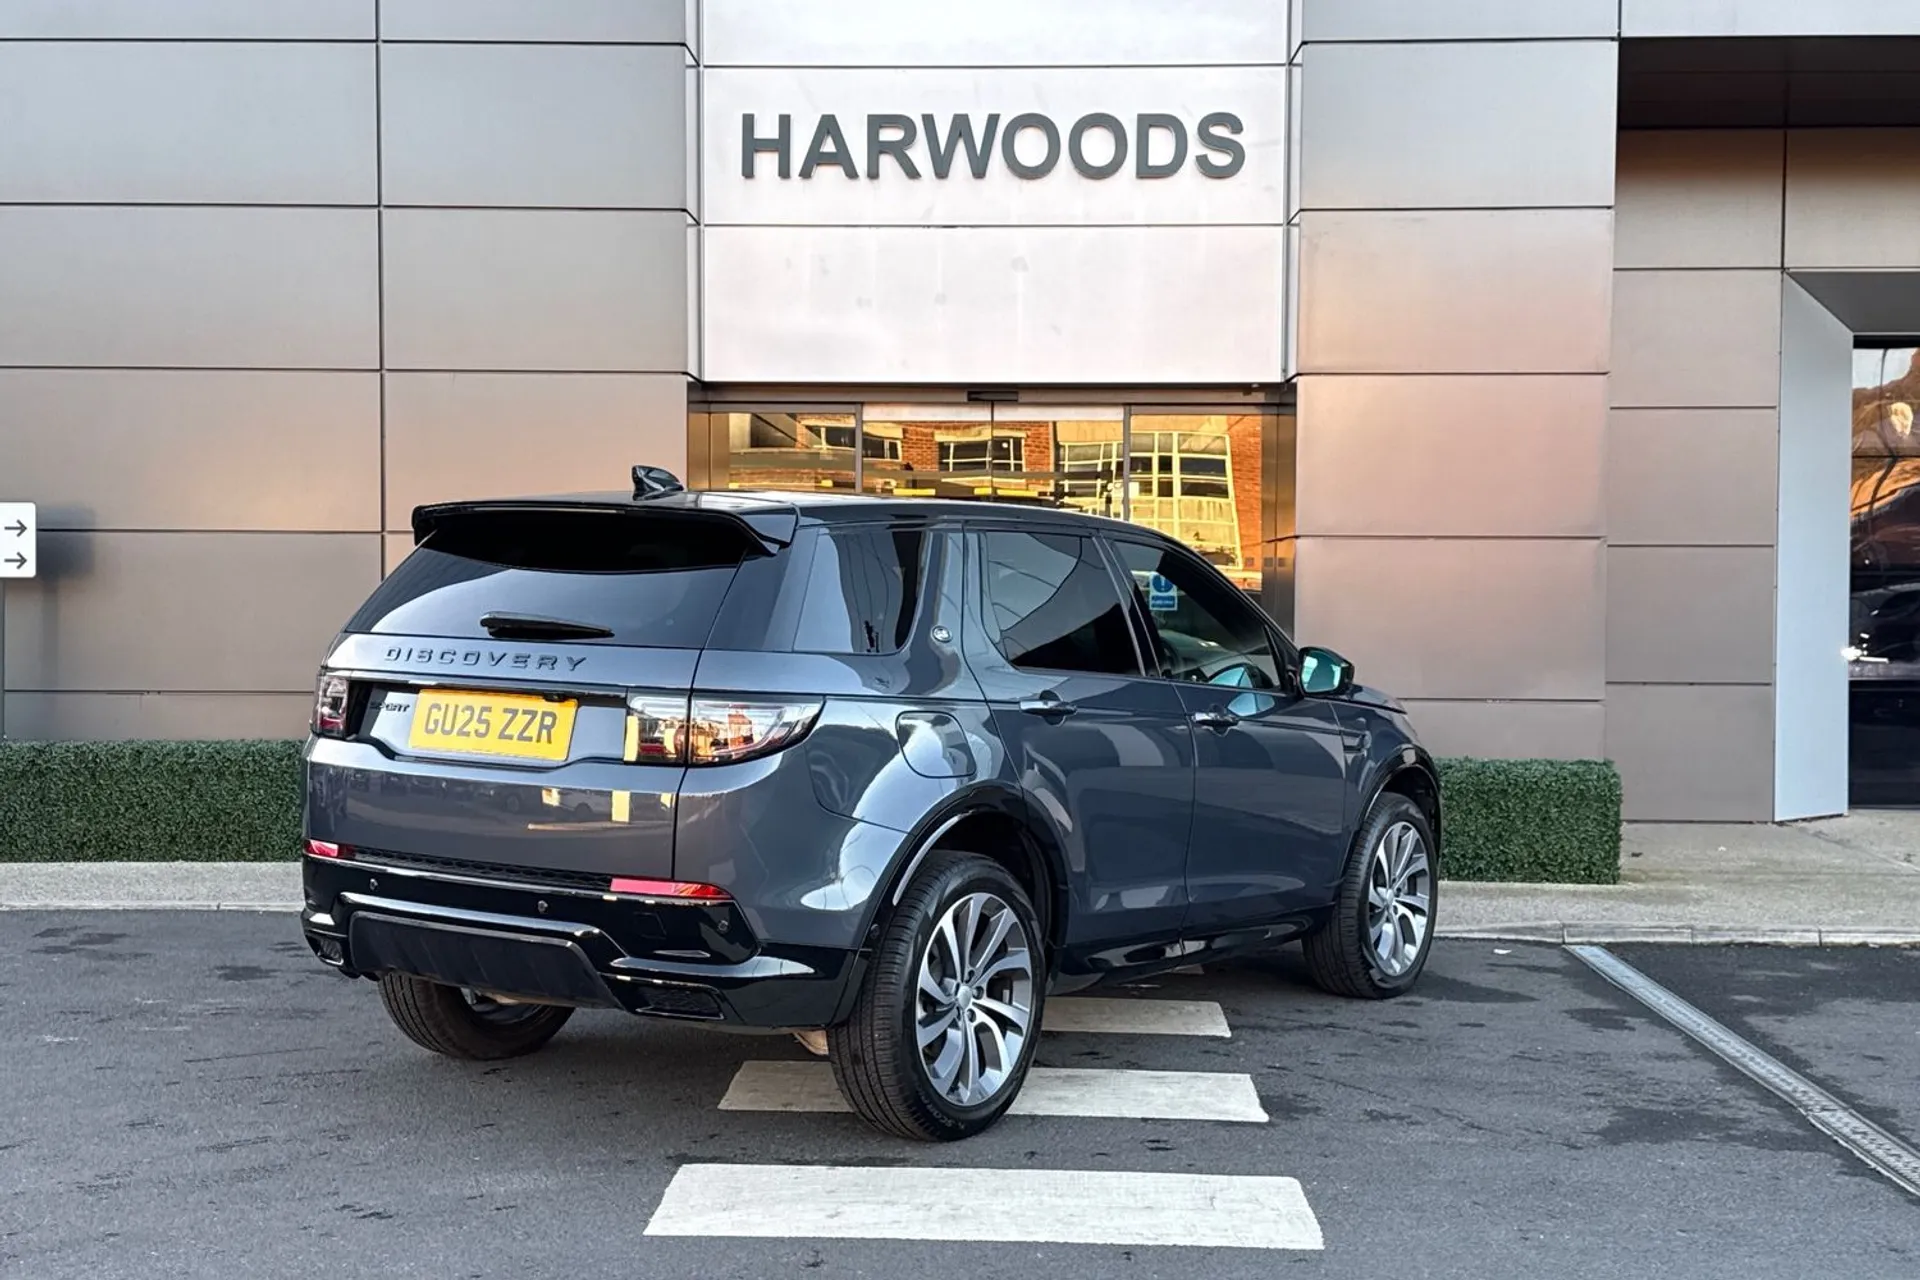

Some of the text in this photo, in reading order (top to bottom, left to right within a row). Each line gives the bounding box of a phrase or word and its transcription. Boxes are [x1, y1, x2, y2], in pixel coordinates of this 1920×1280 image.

[741, 111, 1246, 180] HARWOODS
[384, 647, 587, 672] DISCOVERY
[423, 702, 558, 744] GU25 ZZR
